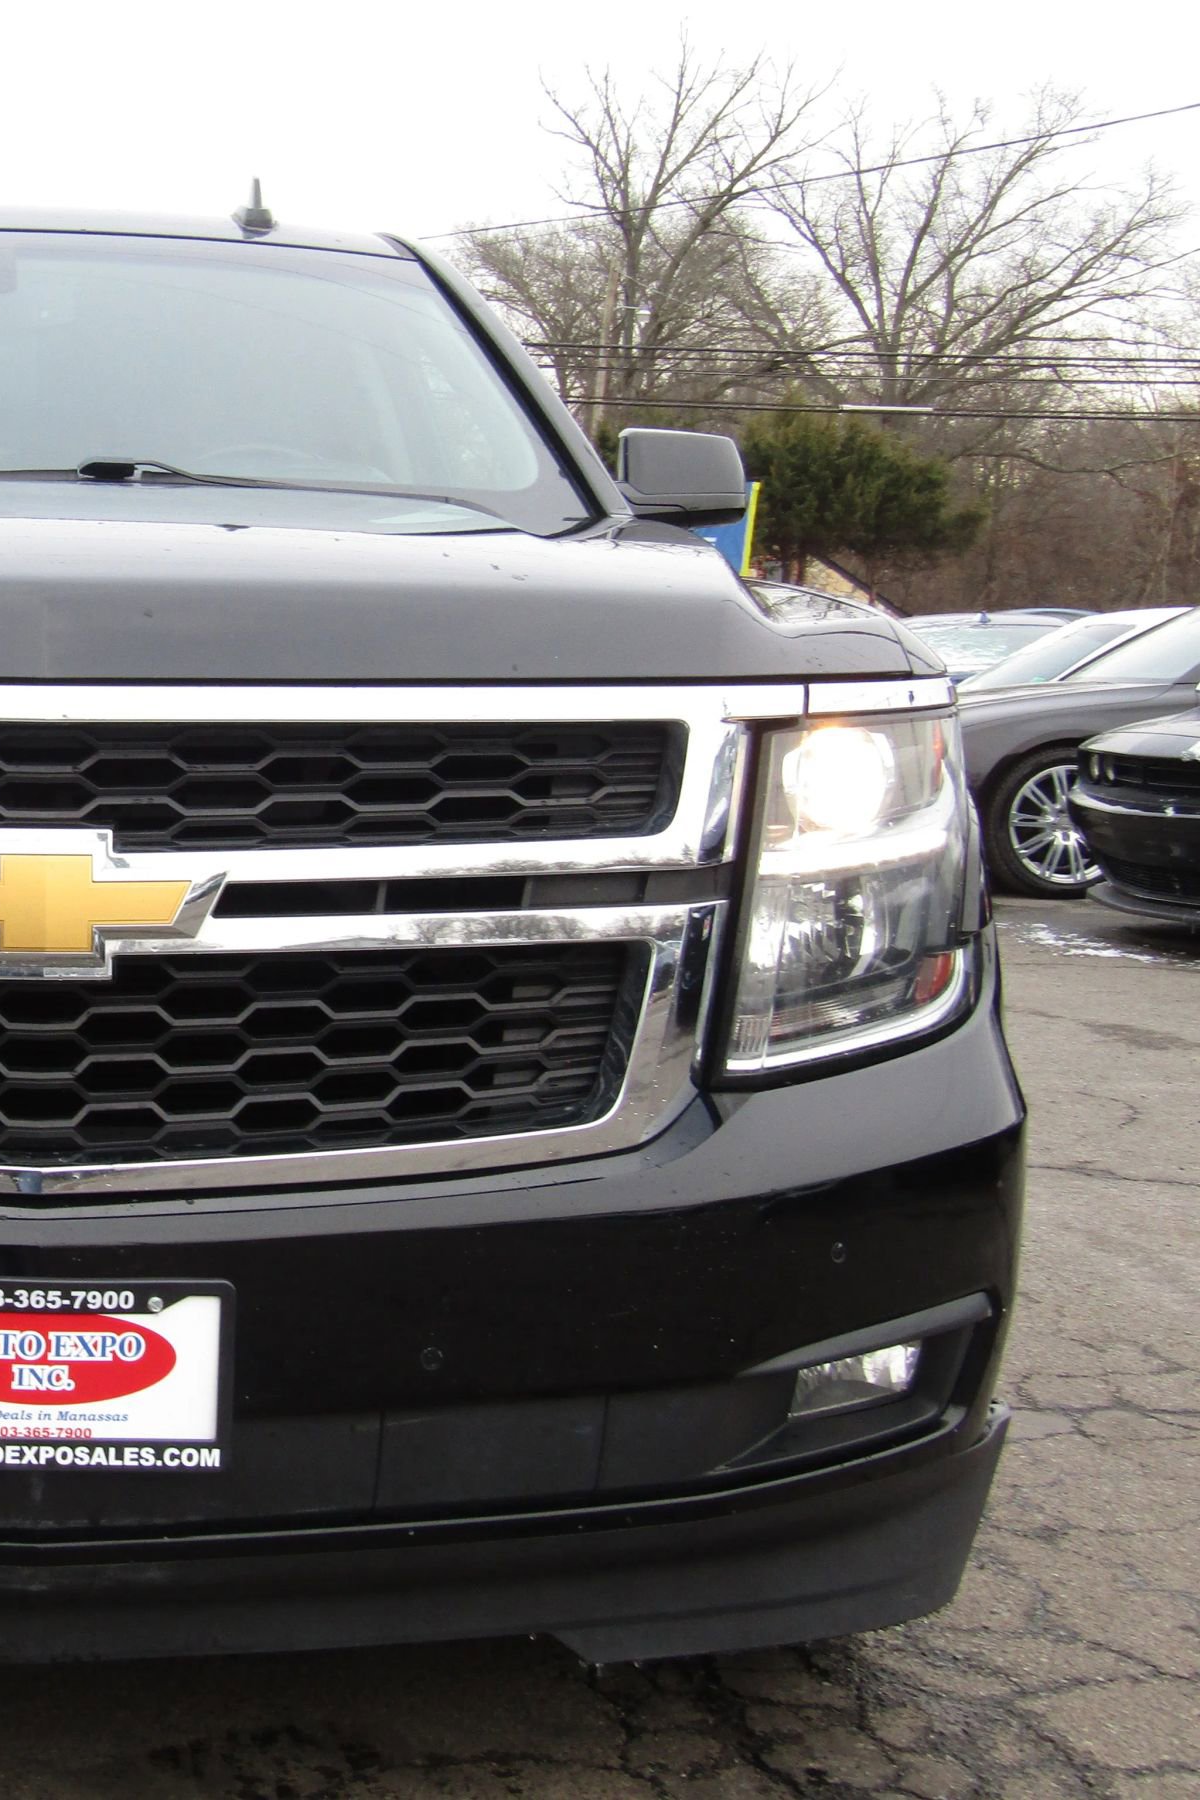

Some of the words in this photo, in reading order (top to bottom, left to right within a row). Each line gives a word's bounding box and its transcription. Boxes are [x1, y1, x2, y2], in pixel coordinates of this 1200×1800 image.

[48, 1331, 145, 1361] EXPO
[12, 1364, 75, 1390] INC.
[38, 1410, 52, 1421] in
[57, 1411, 129, 1422] Manassas
